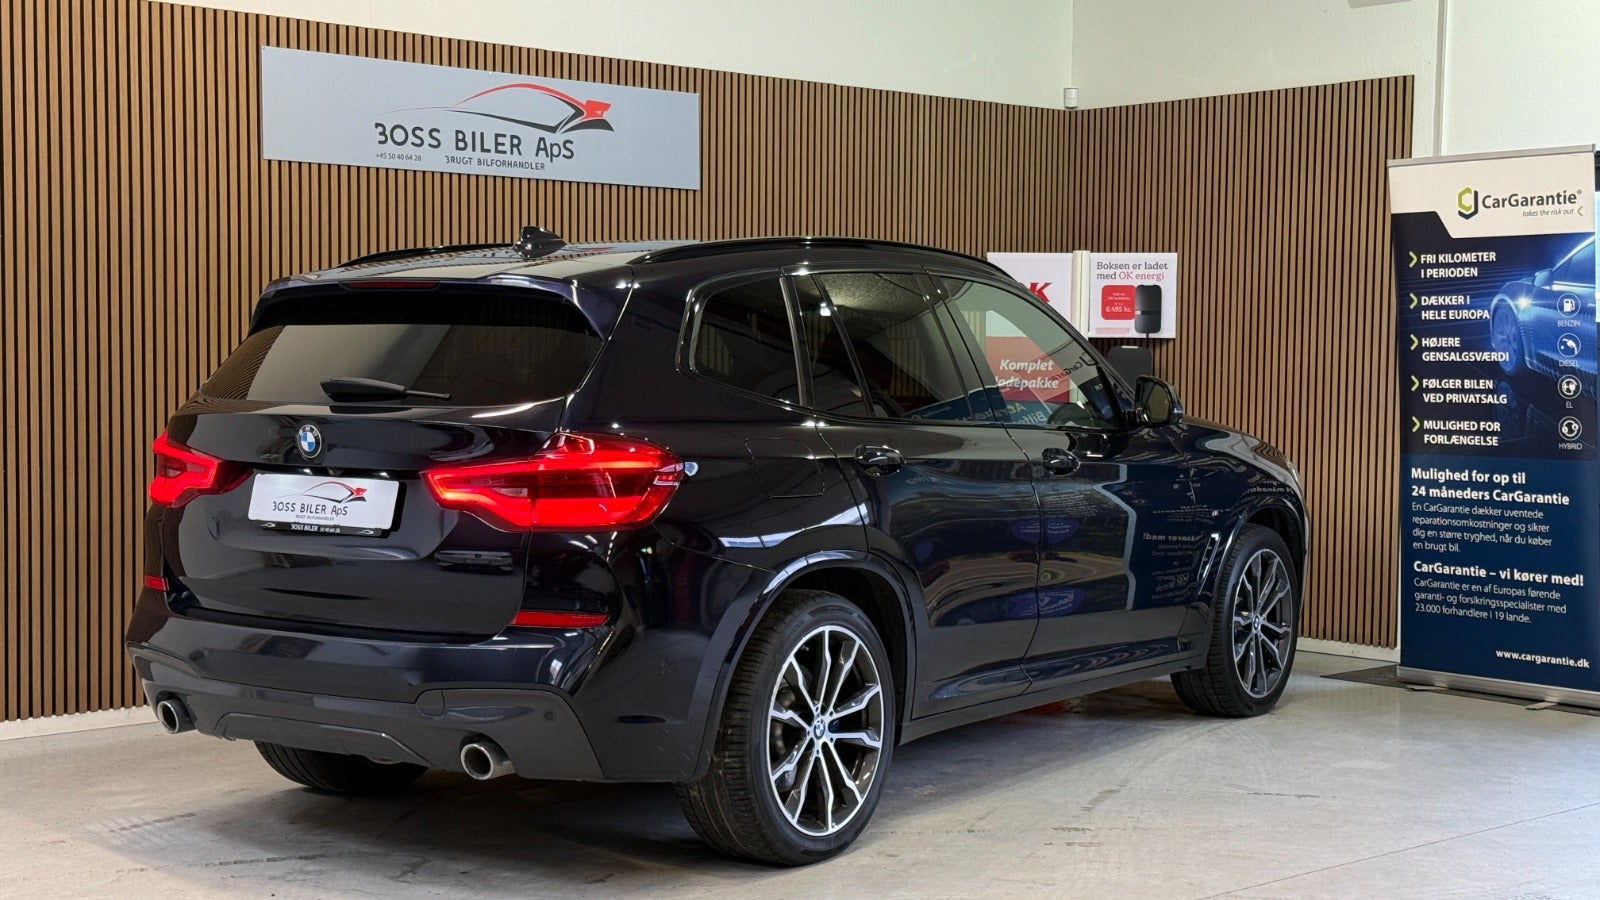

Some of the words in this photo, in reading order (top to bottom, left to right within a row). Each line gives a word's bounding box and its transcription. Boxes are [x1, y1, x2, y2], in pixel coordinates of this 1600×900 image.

[455, 129, 522, 156] BILER
[535, 136, 574, 163] ApS
[397, 153, 404, 161] 40
[477, 158, 545, 171] BILFORHANDLER
[1522, 209, 1538, 217] takes
[1540, 209, 1550, 217] the
[1550, 208, 1562, 216] risk
[1563, 208, 1574, 216] out
[1421, 254, 1436, 264] FRI
[1439, 252, 1496, 264] KILOMETER
[1096, 261, 1130, 270] Boksen
[1144, 261, 1168, 270] ladet
[1096, 271, 1116, 280] med
[1119, 271, 1133, 280] OK
[1135, 271, 1165, 282] energi
[1421, 269, 1424, 278] I
[1426, 267, 1478, 278] PERIODEN
[1421, 296, 1464, 306] DÆKKER
[1466, 295, 1470, 305] I
[1422, 311, 1447, 320] HELE
[1449, 310, 1490, 320] EUROPA
[1422, 337, 1461, 348] HØJERE
[1422, 352, 1509, 362] GENSALGSVÆRDI
[1559, 359, 1579, 367] DIESEL
[1000, 359, 1054, 373] Komplet
[1422, 378, 1462, 389] FØLGER
[1464, 379, 1493, 390] BILEN
[1423, 393, 1444, 403] VED
[1446, 394, 1508, 404] PRIVATSALG
[1566, 401, 1573, 409] EL
[1424, 420, 1477, 431] MULIGHED
[1480, 421, 1500, 431] FOR
[1424, 435, 1499, 446] FORLÆNGELSE
[1411, 467, 1469, 483] Mulighed
[1472, 470, 1490, 483] for
[1493, 474, 1509, 486] op
[1512, 472, 1526, 484] til
[1411, 486, 1426, 497] 24
[1429, 486, 1490, 500] måneders
[1493, 490, 1570, 505] CarGarantie
[300, 503, 326, 514] BILER
[331, 505, 348, 517] ApS
[1412, 502, 1422, 511] En
[1423, 502, 1470, 514] CarGarantie
[1471, 506, 1502, 516] dækker
[1504, 509, 1544, 519] uventede
[1412, 516, 1512, 532] reparationsomkostninger
[1514, 523, 1526, 532] og
[1527, 522, 1550, 533] sikrer
[1413, 528, 1425, 539] dig
[1439, 530, 1462, 540] større
[1463, 532, 1498, 544] tryghed,
[1500, 533, 1513, 544] når
[1514, 535, 1526, 544] du
[1528, 535, 1552, 546] køber
[1425, 541, 1447, 552] brugt
[1449, 542, 1461, 552] bil.
[1413, 561, 1487, 578] CarGarantie
[1500, 569, 1511, 580] vi
[1514, 569, 1548, 583] kører
[1551, 574, 1584, 586] med!
[1414, 578, 1460, 590] CarGarantie
[1483, 583, 1492, 593] af
[1493, 585, 1526, 598] Europas
[1528, 588, 1561, 600] førende
[1414, 591, 1445, 602] garanti-
[1446, 595, 1457, 605] og
[1459, 594, 1545, 612] forsikringsspecialister
[1547, 604, 1567, 614] med
[1415, 603, 1441, 614] 23.000
[1442, 604, 1488, 619] forhandlere
[1495, 611, 1504, 620] 19
[1506, 612, 1531, 623] lande.
[1496, 649, 1590, 669] www.cargarantie.dk
